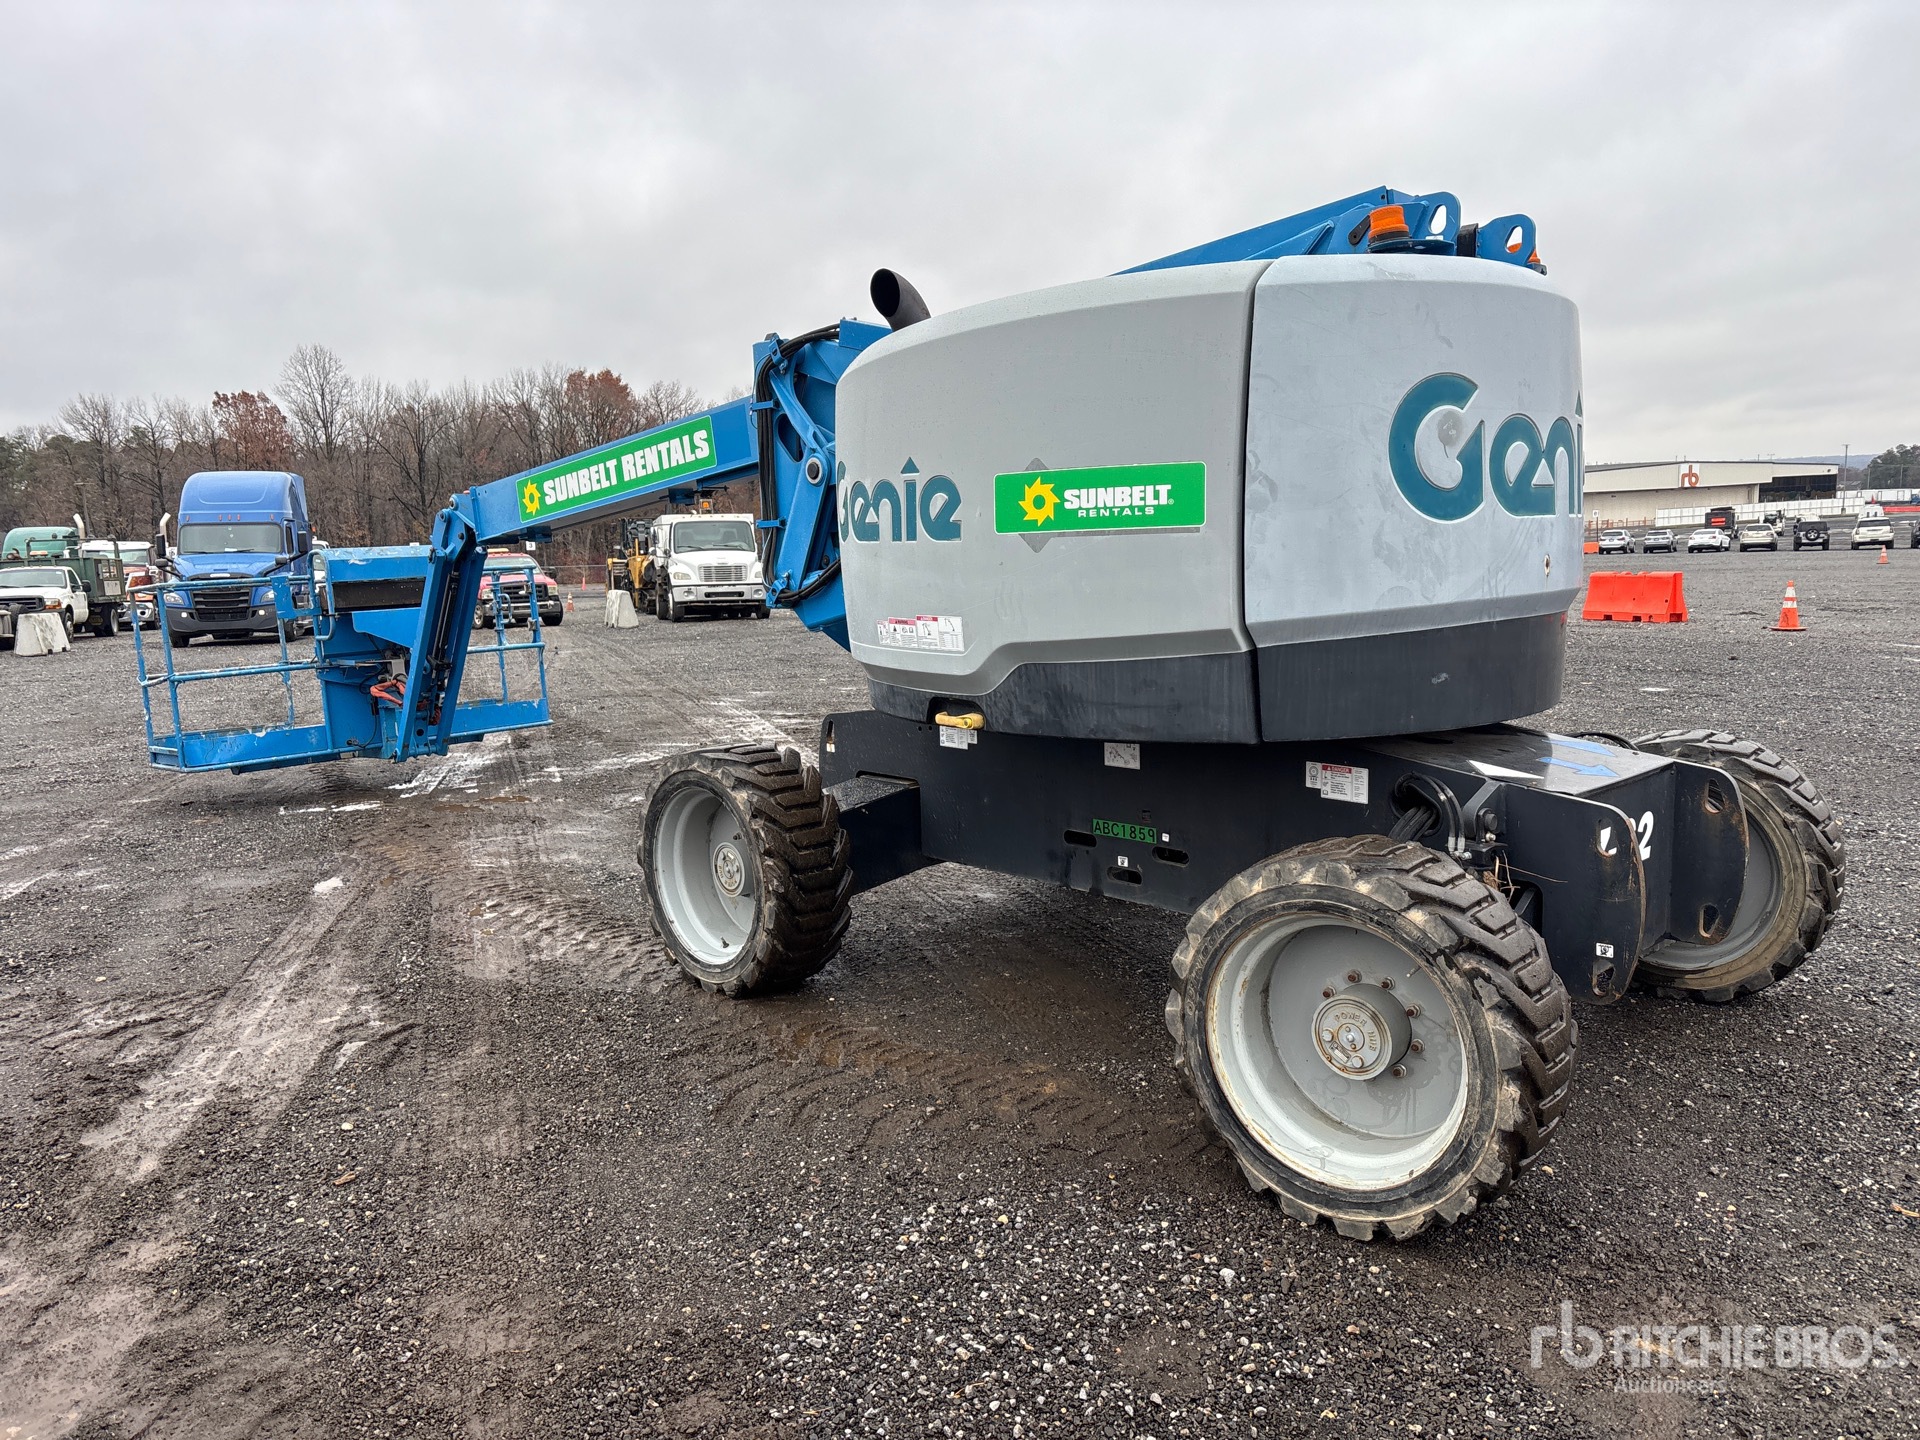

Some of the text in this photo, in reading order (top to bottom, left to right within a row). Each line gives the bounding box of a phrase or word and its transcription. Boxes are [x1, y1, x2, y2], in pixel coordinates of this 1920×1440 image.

[543, 430, 710, 505] SUNBELT RENTALS
[1680, 464, 1700, 487] rb
[1078, 507, 1155, 518] RENTALS
[1094, 820, 1155, 843] ABC1859
[1335, 1011, 1367, 1027] POWER
[1367, 1030, 1377, 1052] HUB
